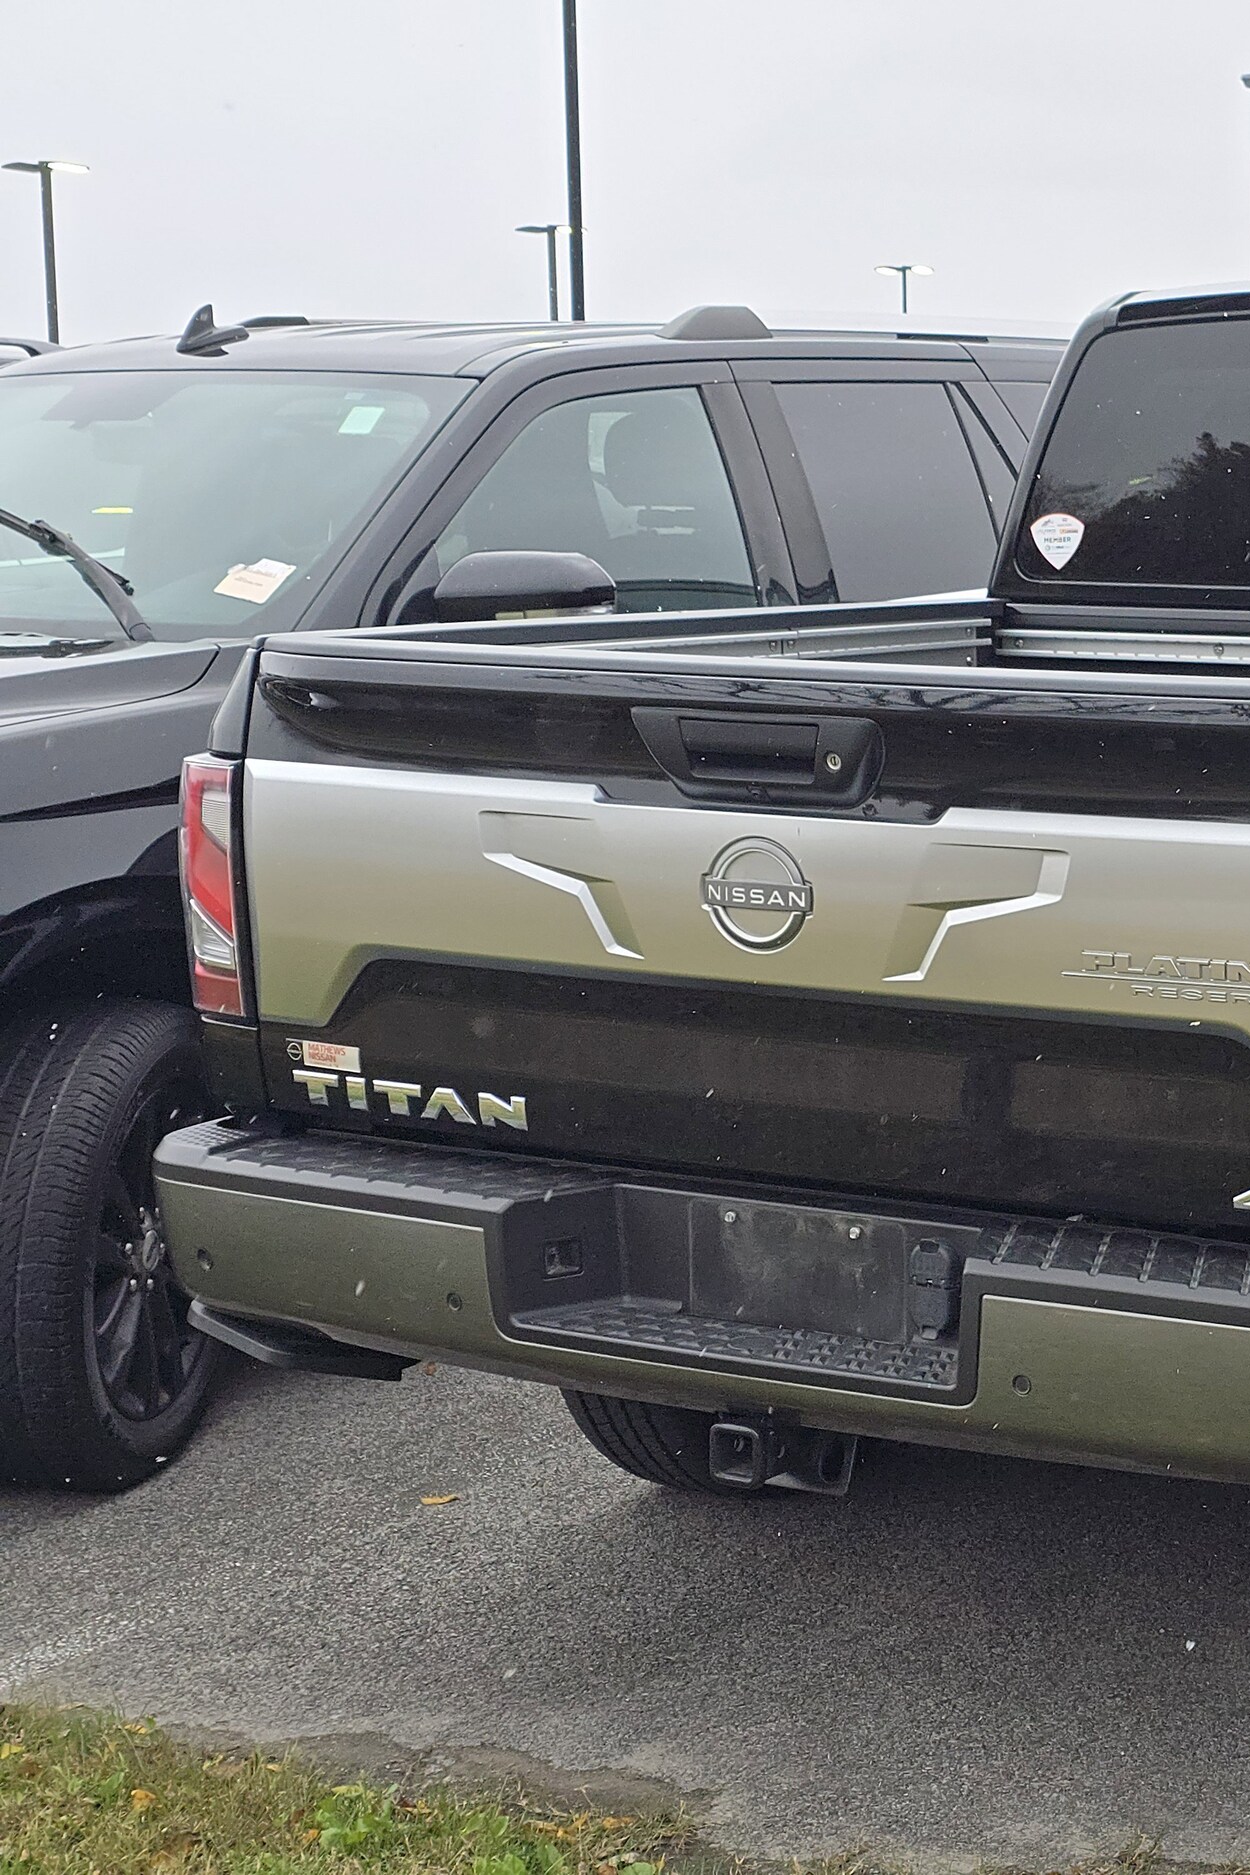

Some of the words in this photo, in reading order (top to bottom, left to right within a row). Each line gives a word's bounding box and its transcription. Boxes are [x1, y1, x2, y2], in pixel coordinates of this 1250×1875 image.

[707, 884, 806, 908] NISSAN
[308, 1052, 337, 1063] NISSAN
[292, 1069, 529, 1132] TITAN
